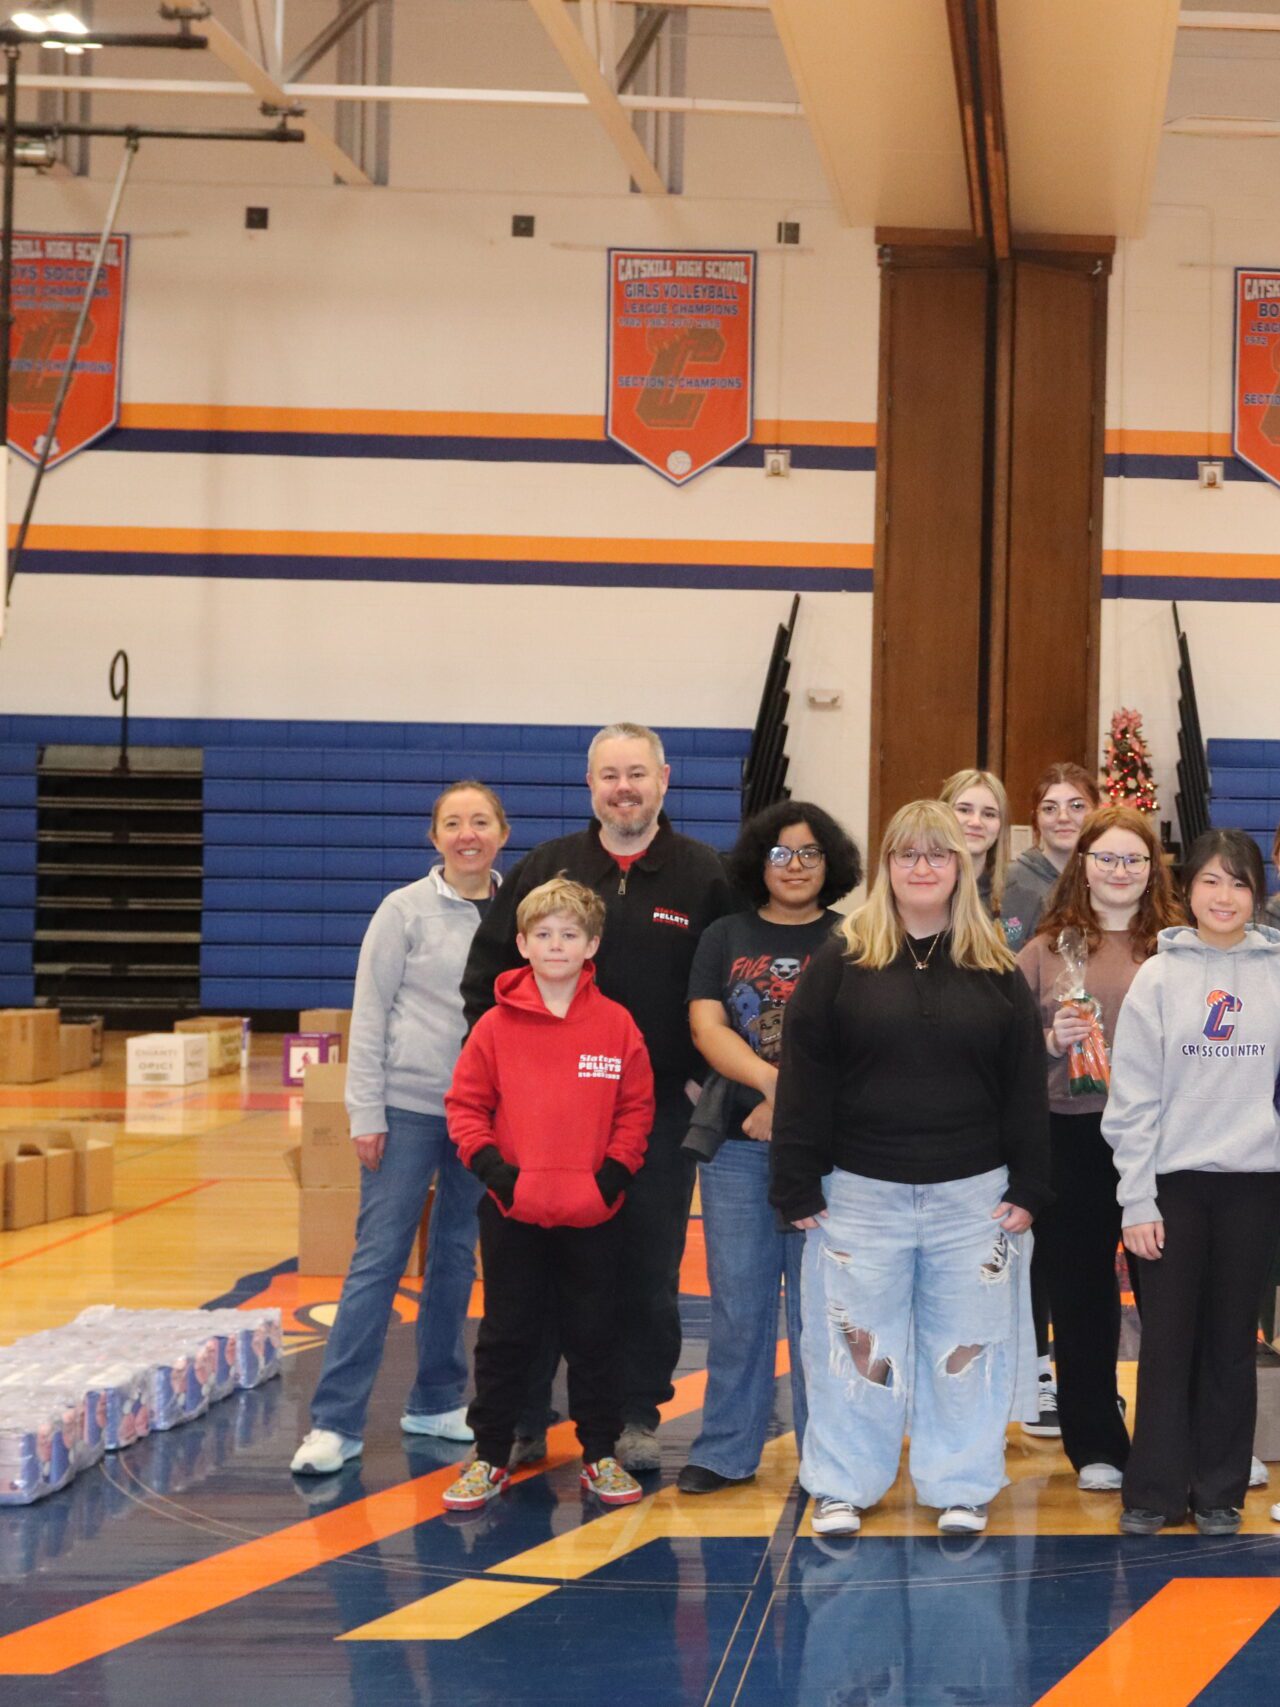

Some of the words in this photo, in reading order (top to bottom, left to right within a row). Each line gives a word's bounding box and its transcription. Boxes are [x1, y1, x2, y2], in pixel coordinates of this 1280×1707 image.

[618, 258, 673, 282] CATSKILL
[675, 259, 704, 277] HIGH
[705, 260, 748, 284] SCHOOL
[625, 284, 660, 299] GIRLS
[664, 284, 739, 300] VOLLEYBALL
[624, 303, 668, 315] LEAGUE
[672, 304, 739, 316] CHAMPIONS
[618, 376, 665, 388] SECTION
[668, 378, 676, 388] 2
[679, 378, 742, 389] CHAMPIONS
[727, 954, 773, 987] FIVE
[578, 1062, 622, 1073] PELLETS
